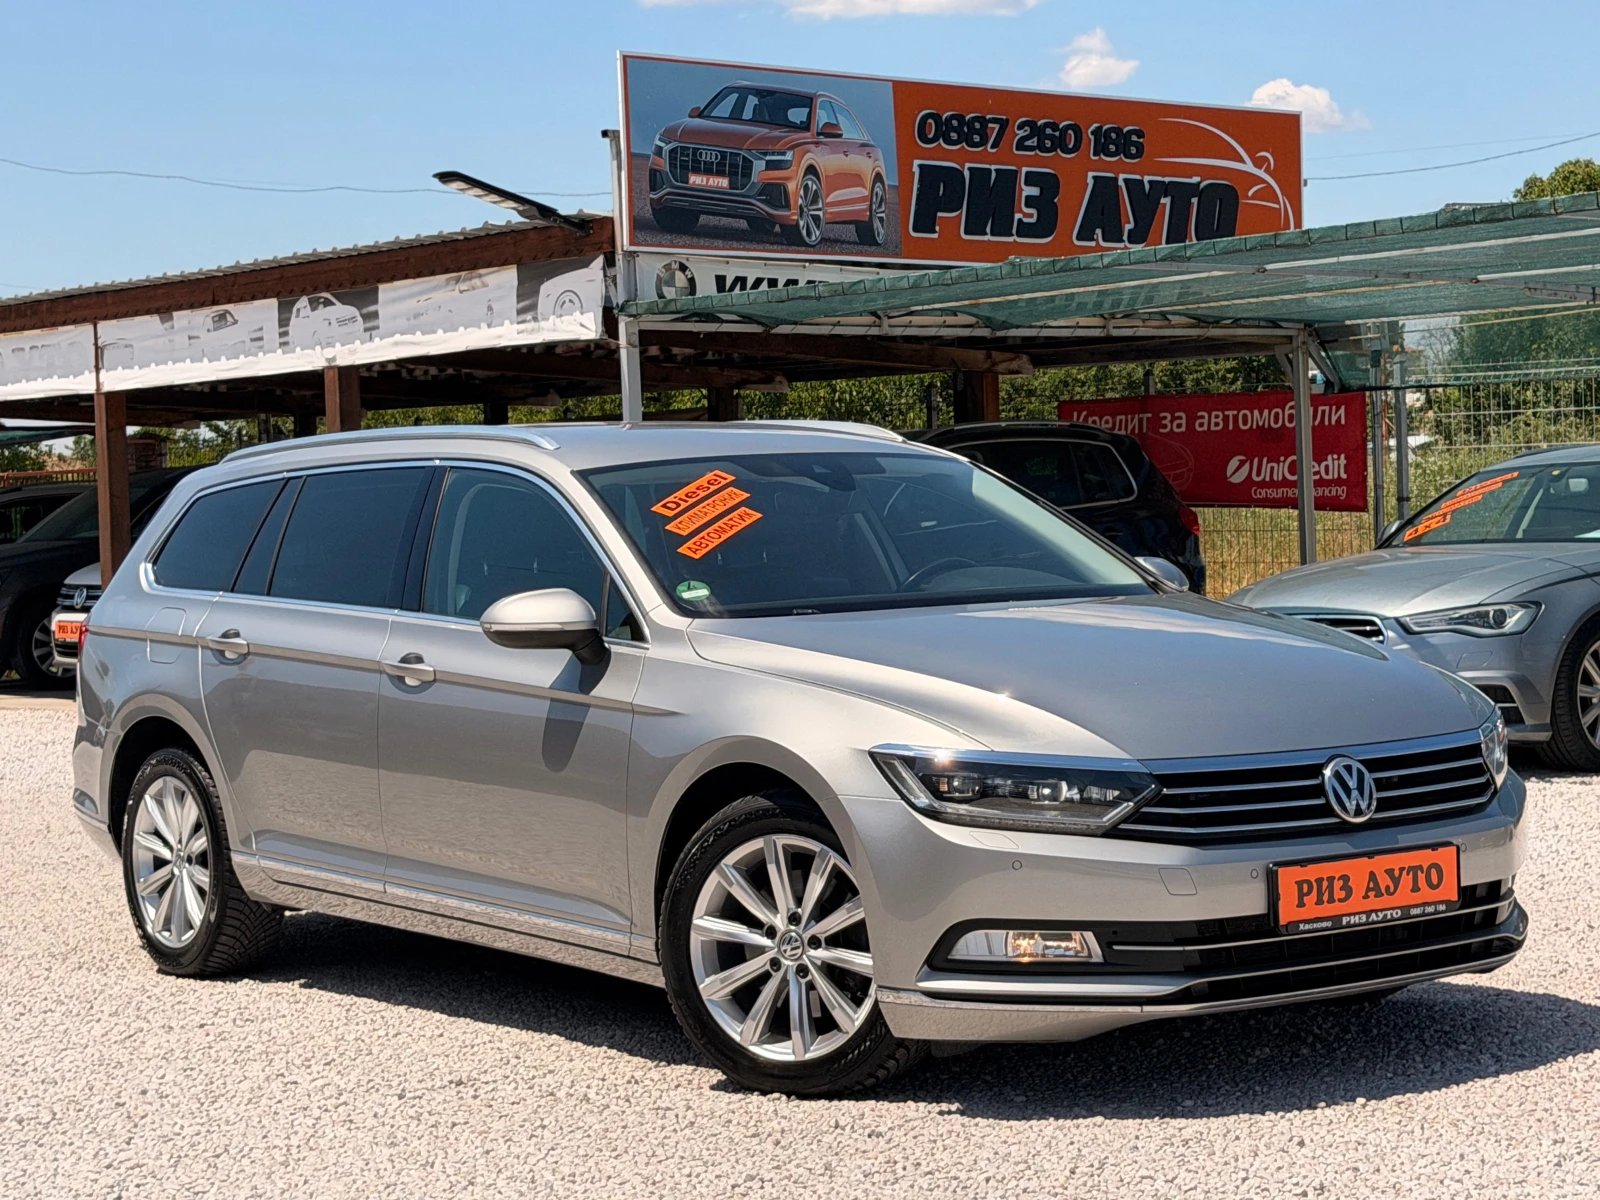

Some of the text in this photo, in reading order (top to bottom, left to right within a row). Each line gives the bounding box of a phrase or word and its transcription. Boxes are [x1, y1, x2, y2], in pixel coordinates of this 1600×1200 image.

[915, 110, 1146, 162] 0887 260 186
[708, 176, 729, 188] АУТО
[909, 160, 1240, 249] РИЗ АУТО
[1159, 411, 1187, 434] за
[1194, 401, 1346, 432] автомобли
[1251, 453, 1348, 482] UniCedit
[660, 473, 728, 512] Diesel
[686, 509, 754, 555] АВТОМАТИК
[1295, 862, 1444, 908] РИЗ АУТО
[1299, 903, 1447, 931] Хасково РИЗ АУТО 0887 260 186
